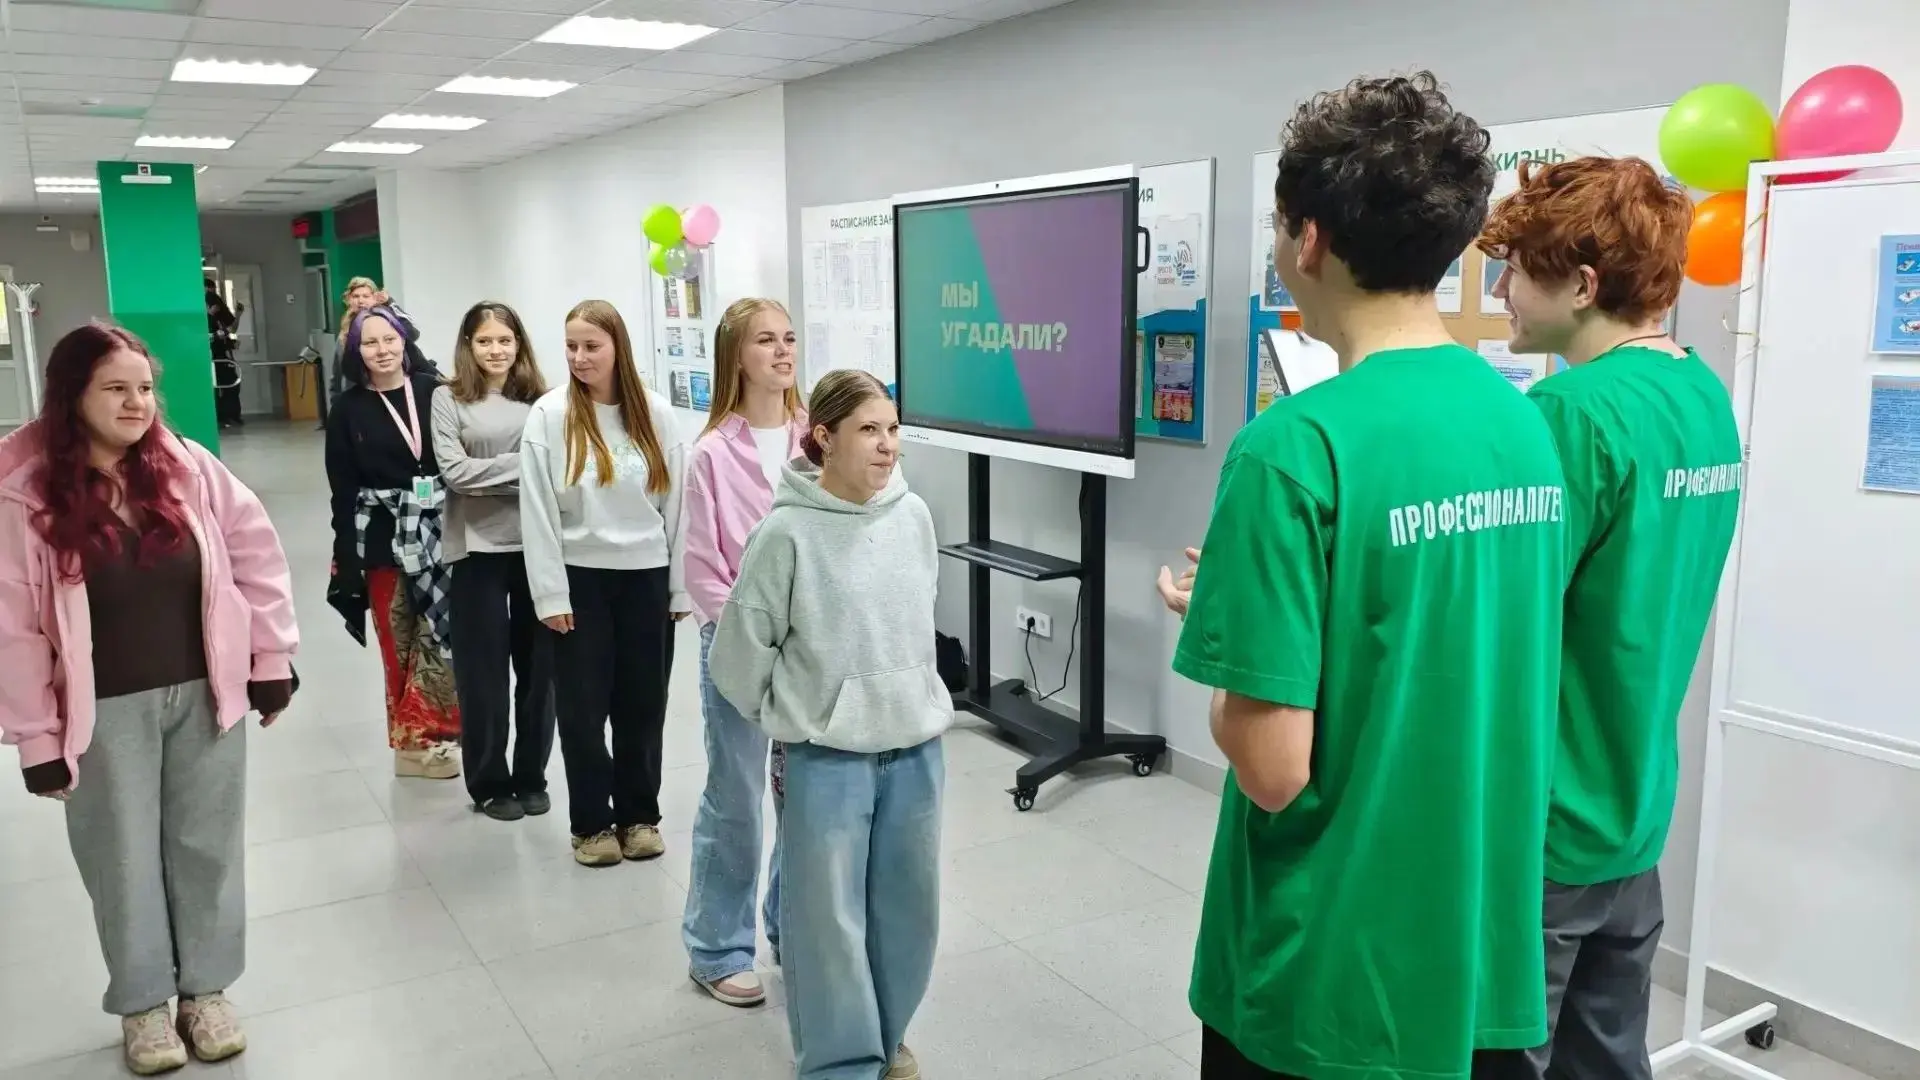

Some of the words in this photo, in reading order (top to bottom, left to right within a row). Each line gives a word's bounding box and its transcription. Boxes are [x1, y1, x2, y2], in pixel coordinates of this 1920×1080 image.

[830, 215, 878, 229] РАСПИСАНИЕ
[941, 279, 979, 310] МЫ
[941, 321, 1068, 353] УГАДАЛИ?
